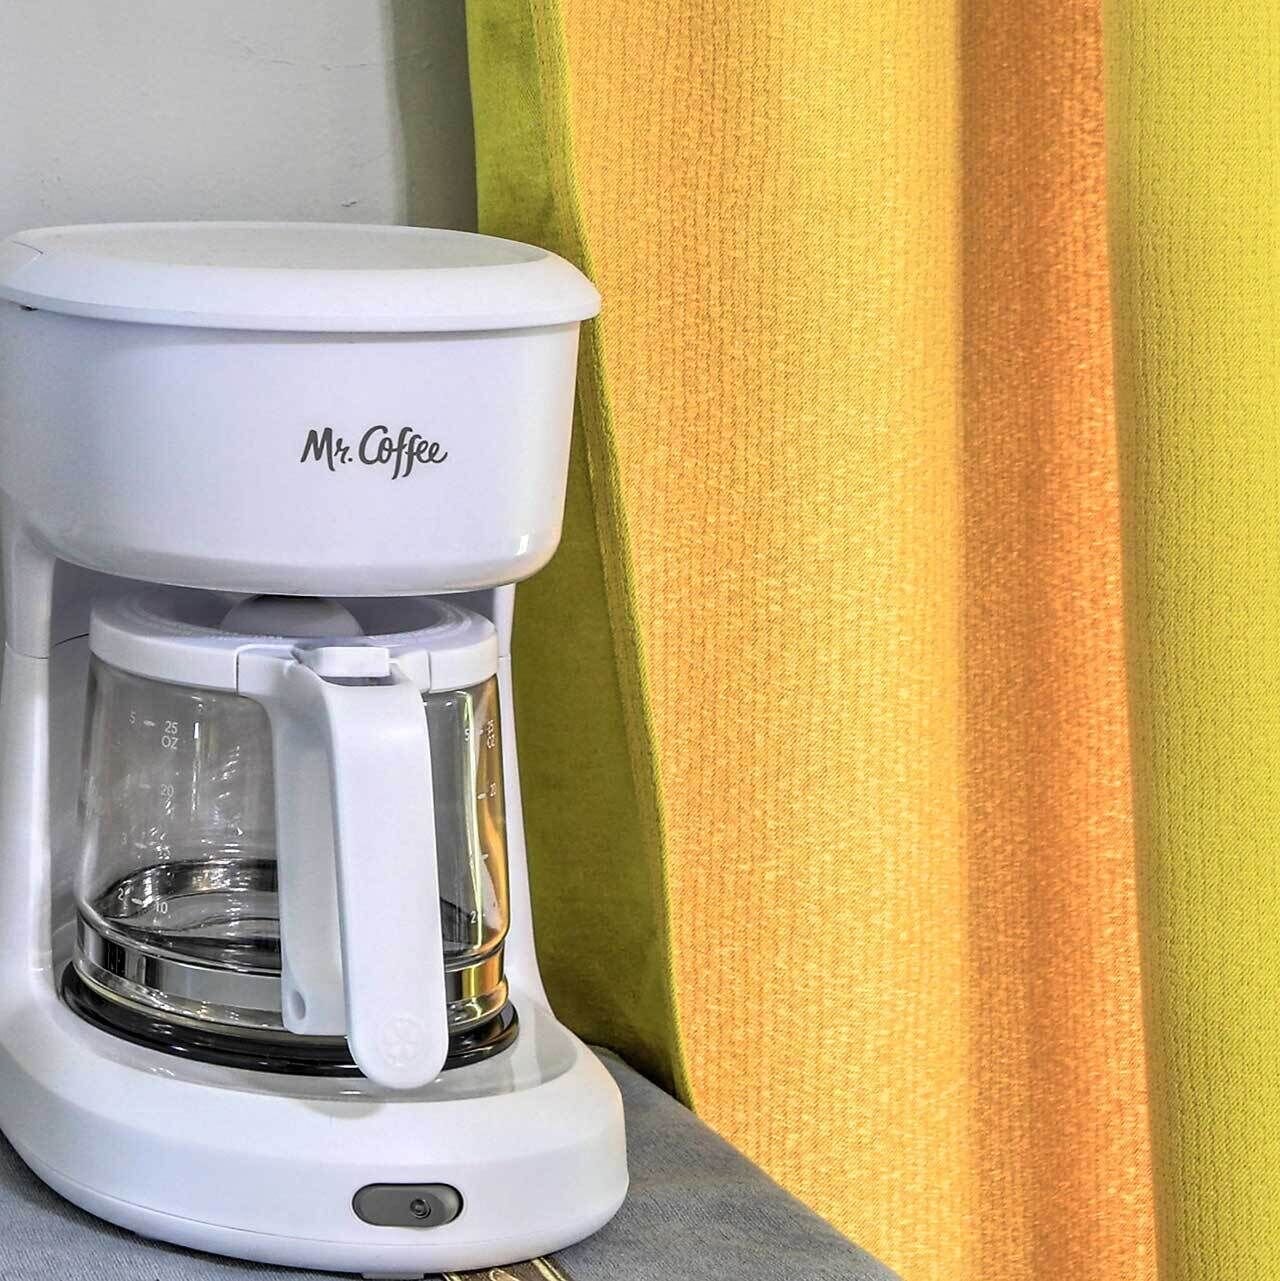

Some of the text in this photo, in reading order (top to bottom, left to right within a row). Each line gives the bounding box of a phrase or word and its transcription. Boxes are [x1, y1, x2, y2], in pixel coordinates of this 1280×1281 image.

[300, 424, 449, 480] Mr. Coffee
[164, 720, 179, 735] 25
[161, 735, 179, 750] OZ
